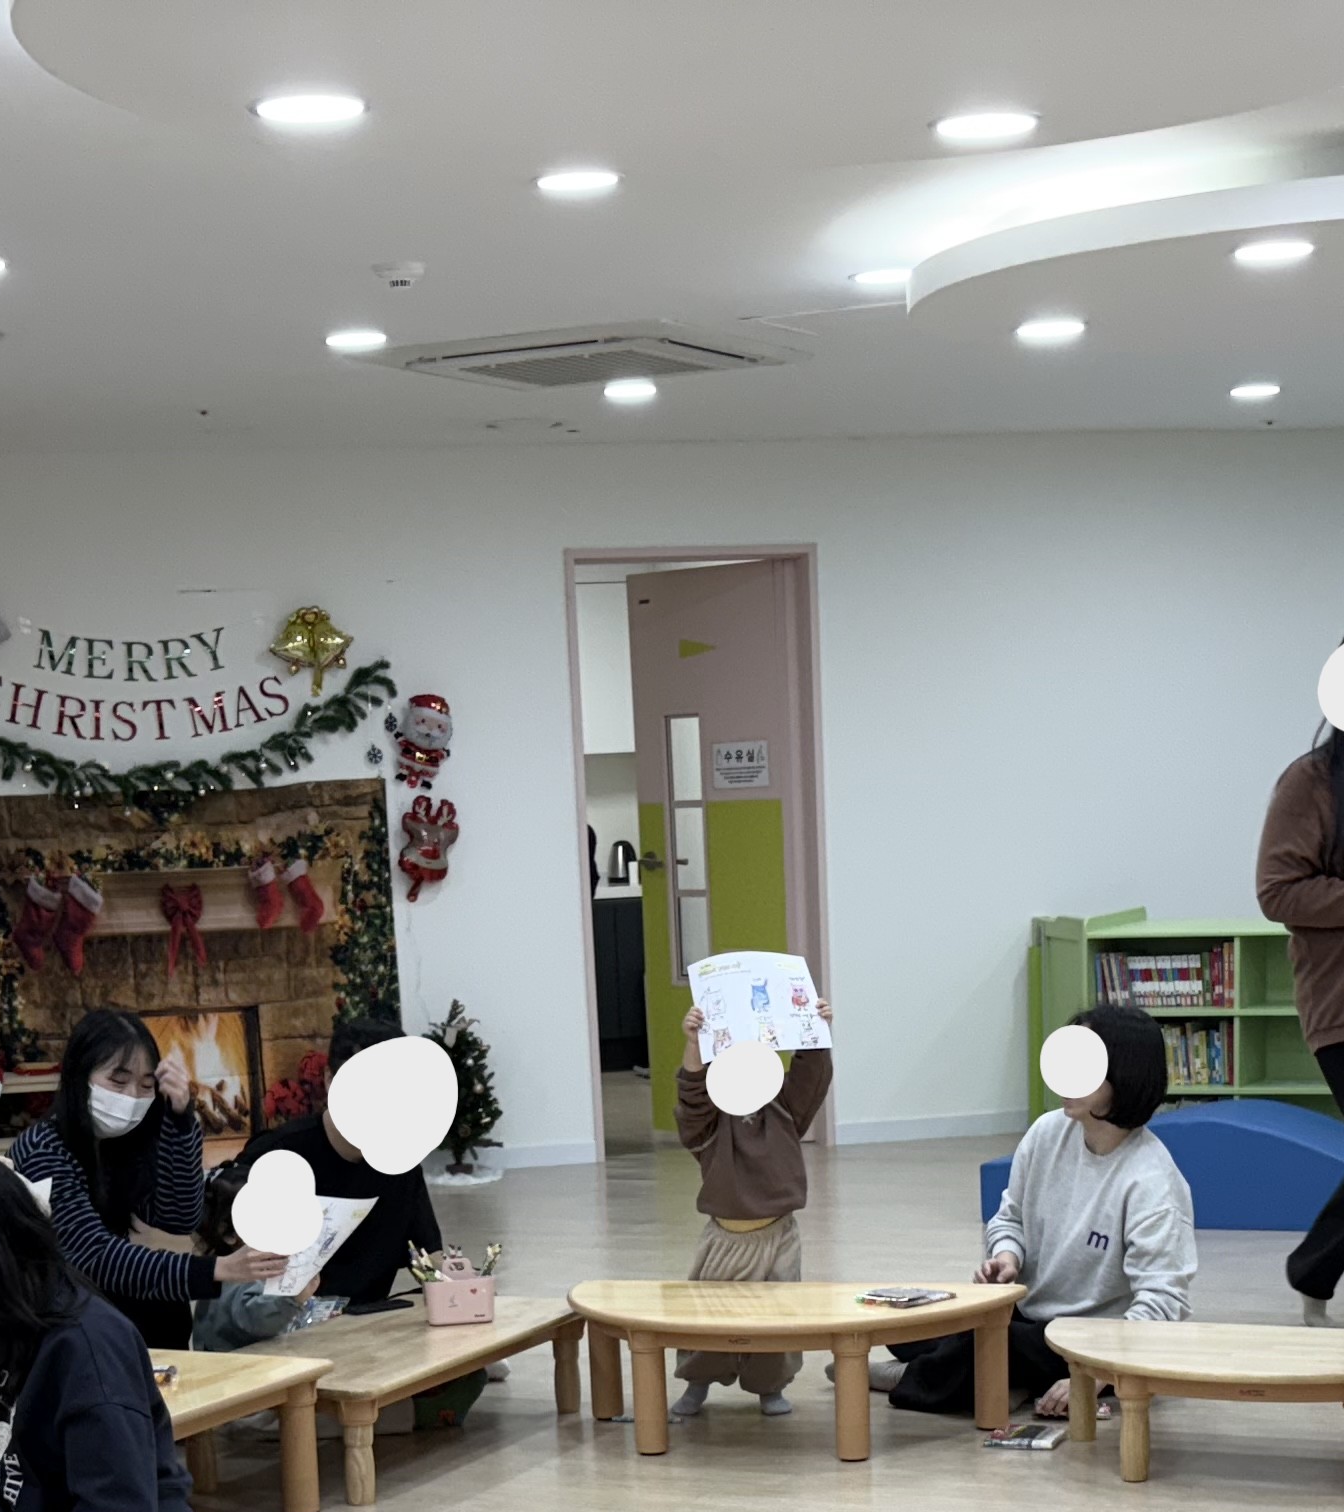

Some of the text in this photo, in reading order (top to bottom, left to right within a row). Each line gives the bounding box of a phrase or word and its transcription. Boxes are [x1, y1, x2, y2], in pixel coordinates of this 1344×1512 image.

[32, 626, 226, 683] MERRY
[723, 748, 755, 764] 수유실
[1086, 1230, 1109, 1251] m
